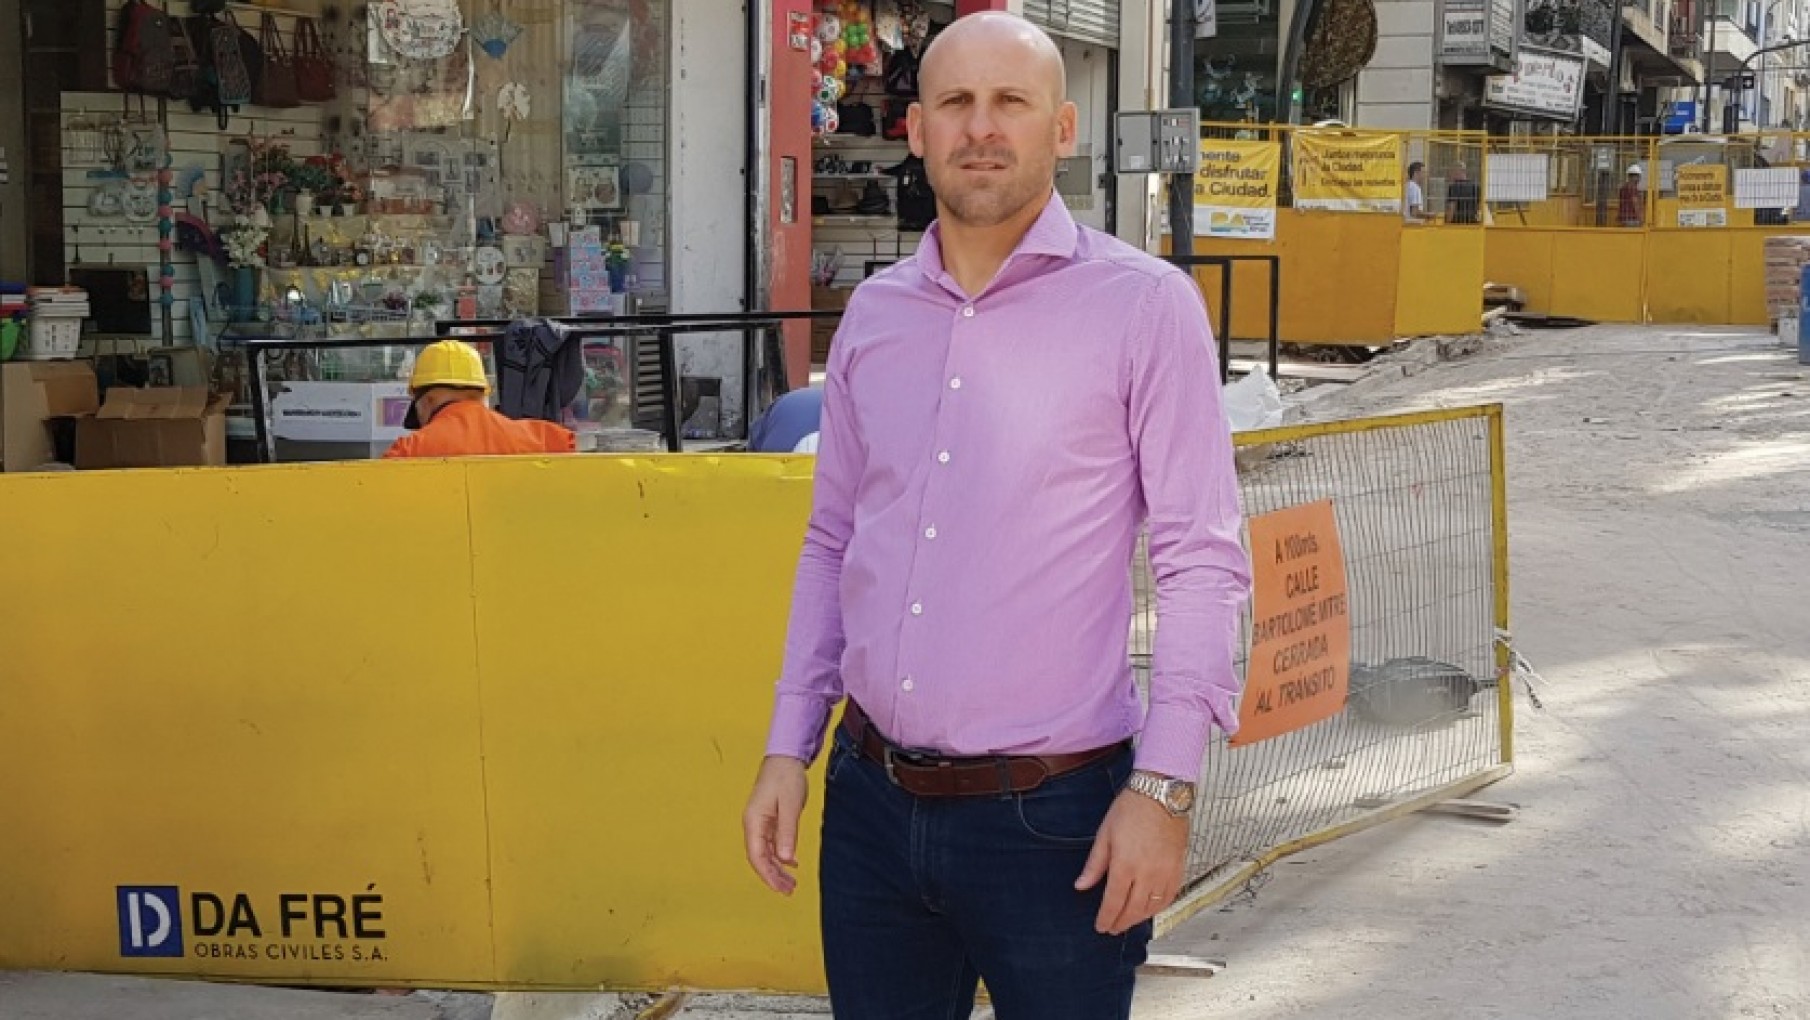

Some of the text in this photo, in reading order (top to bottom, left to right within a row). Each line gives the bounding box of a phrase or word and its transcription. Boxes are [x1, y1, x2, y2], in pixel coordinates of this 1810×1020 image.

[1199, 163, 1268, 181] disfrutar
[1209, 181, 1273, 198] Ciudad.
[1275, 537, 1284, 565] A
[1286, 565, 1320, 599] CALLE
[1318, 592, 1347, 622] MITRE
[1273, 634, 1329, 675] CERRADA
[1253, 686, 1273, 717] AL
[190, 883, 387, 939] DA FRÉ
[194, 941, 389, 961] OBRAS CIVILES S.A.
